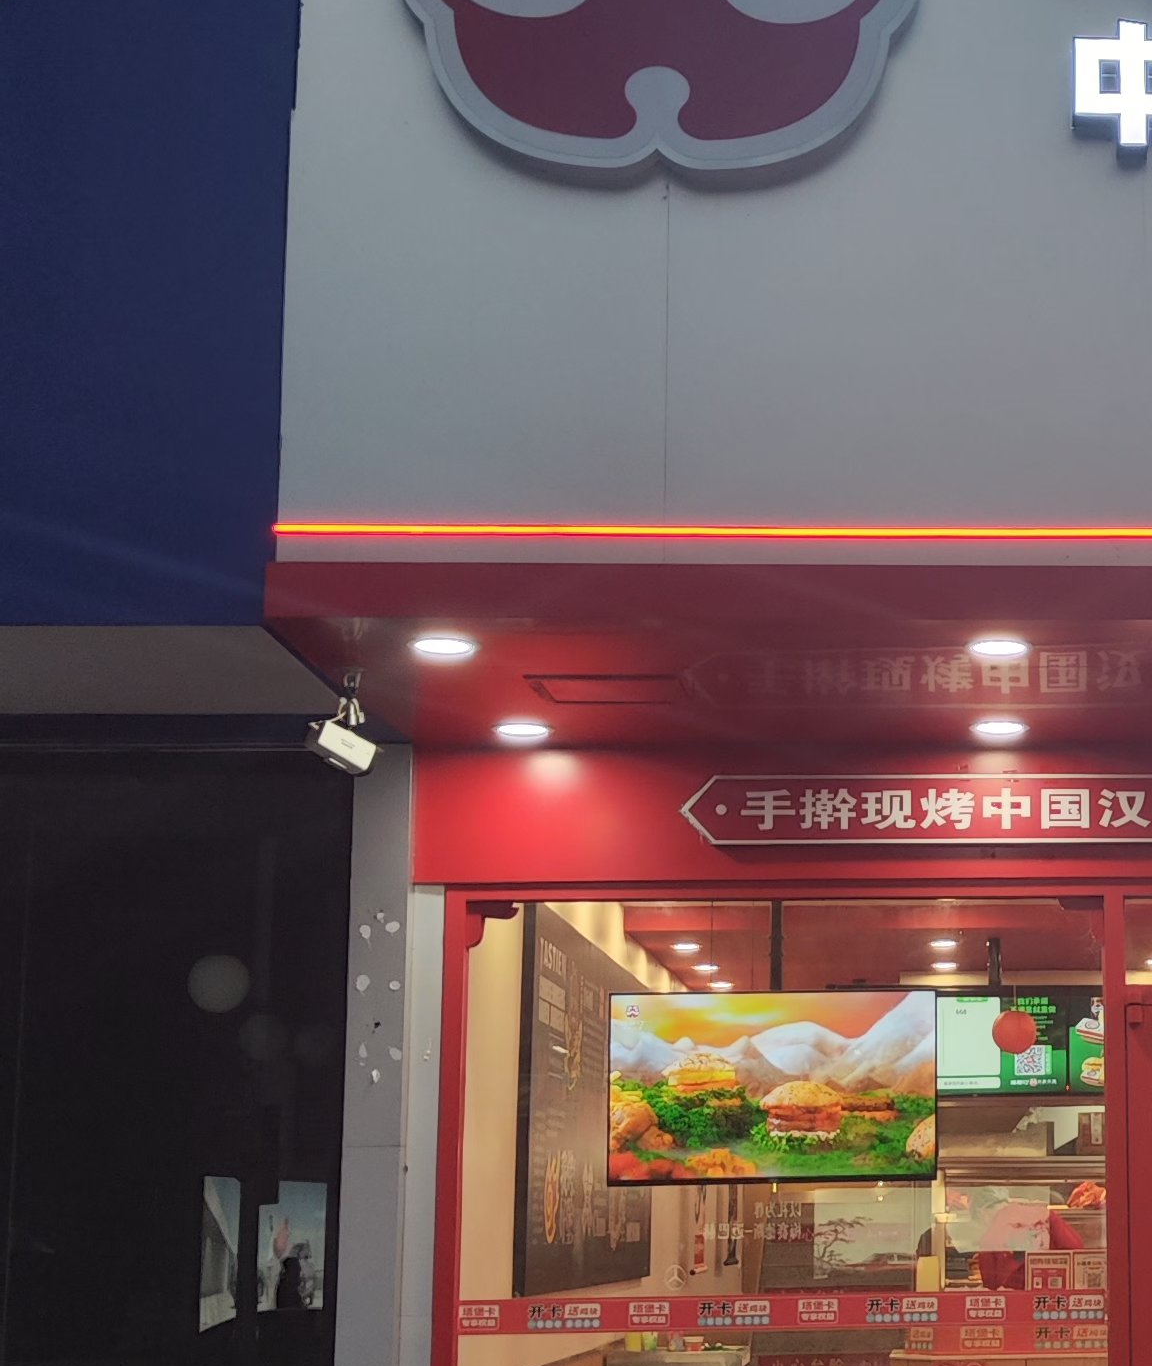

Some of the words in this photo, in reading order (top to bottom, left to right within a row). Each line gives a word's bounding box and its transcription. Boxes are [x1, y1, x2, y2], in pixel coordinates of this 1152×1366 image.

[699, 1302, 732, 1316] 开卡
[866, 1299, 899, 1312] 开卡
[1033, 1297, 1067, 1309] 开卡
[529, 1305, 563, 1318] 开卡
